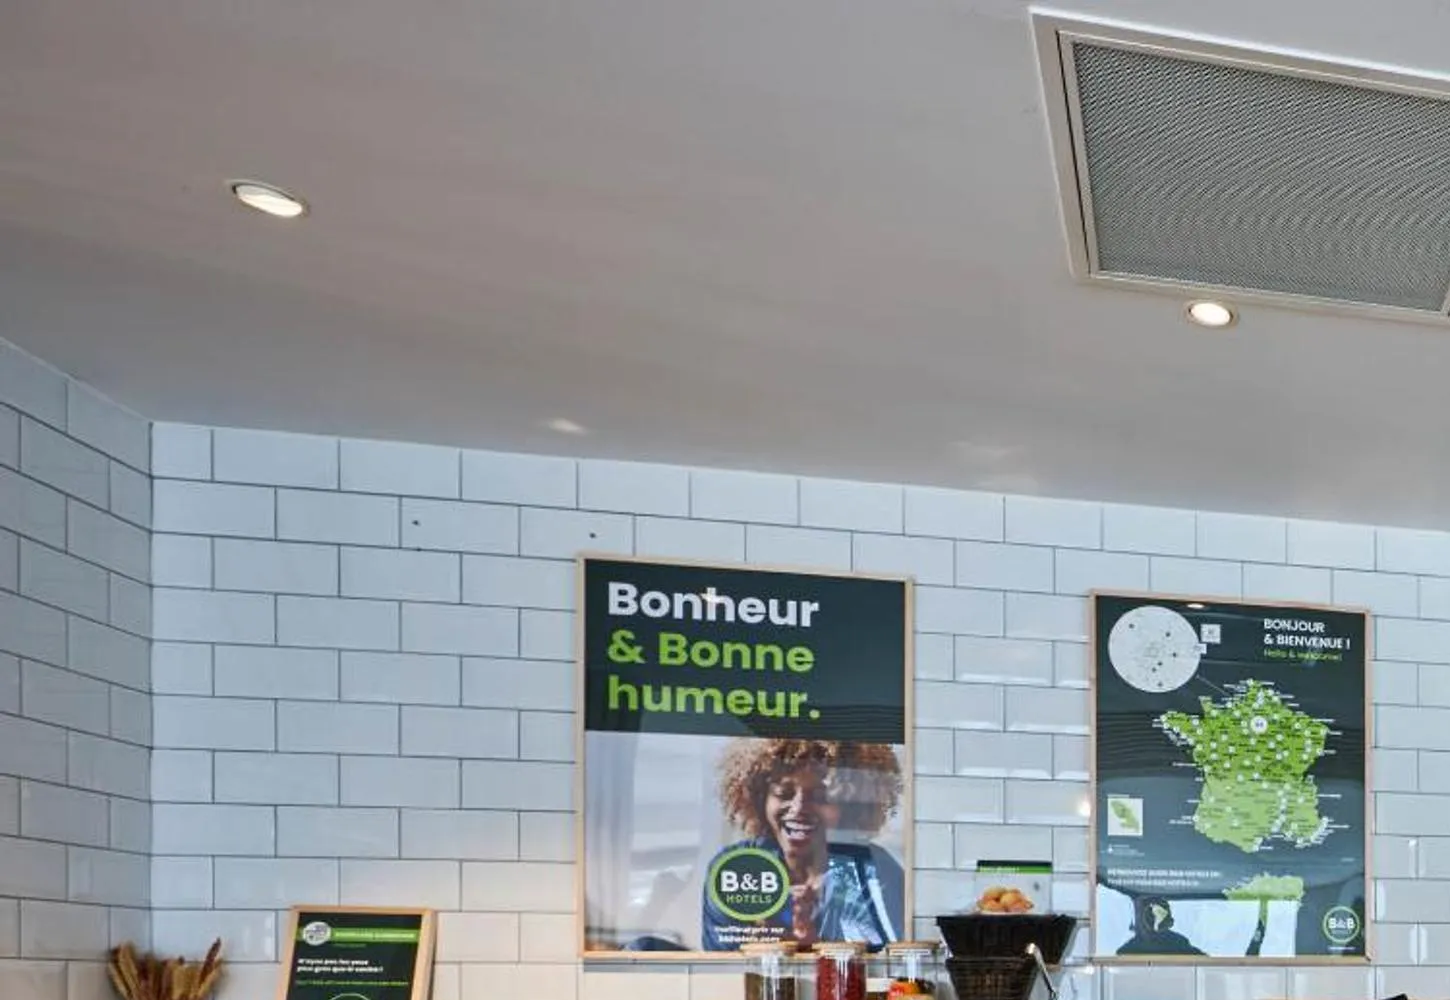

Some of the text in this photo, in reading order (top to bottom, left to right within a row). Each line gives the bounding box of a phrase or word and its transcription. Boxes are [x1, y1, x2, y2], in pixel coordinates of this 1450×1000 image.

[607, 581, 819, 627] Bonheur
[1264, 618, 1326, 633] BONJOUR
[607, 630, 815, 672] & Bonne
[1264, 634, 1274, 645] &
[1277, 634, 1344, 649] BIENVENUE
[607, 675, 821, 720] humeur.
[721, 871, 779, 893] B&B
[726, 894, 773, 904] HOTELS
